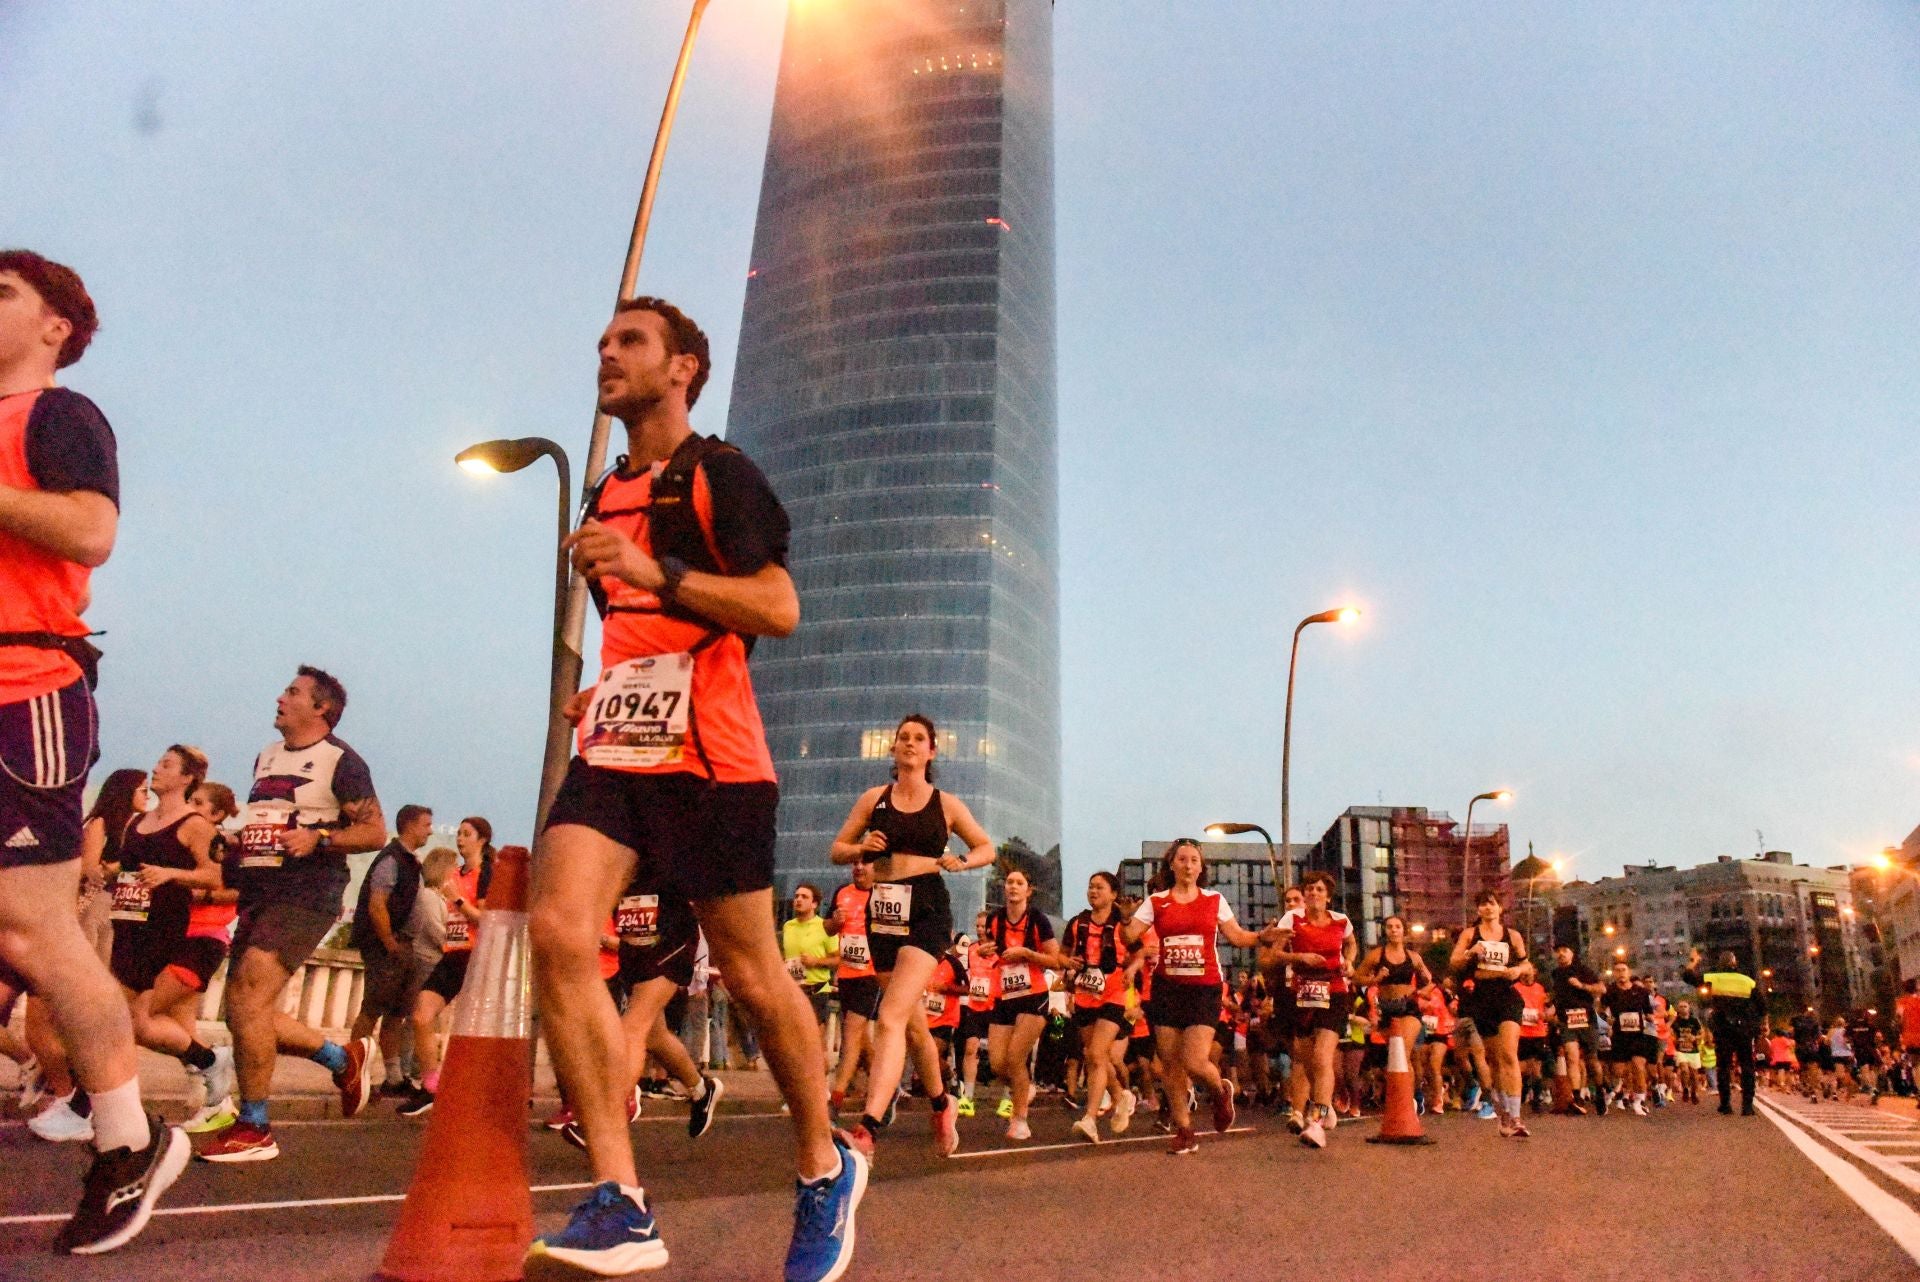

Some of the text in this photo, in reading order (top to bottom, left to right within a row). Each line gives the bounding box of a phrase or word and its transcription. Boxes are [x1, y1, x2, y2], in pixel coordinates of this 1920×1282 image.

[594, 691, 682, 722] 10947
[243, 829, 282, 845] 2323
[874, 900, 902, 914] 5780
[618, 911, 655, 927] 23417
[1166, 948, 1202, 959] 23366
[1299, 984, 1328, 994] 23735
